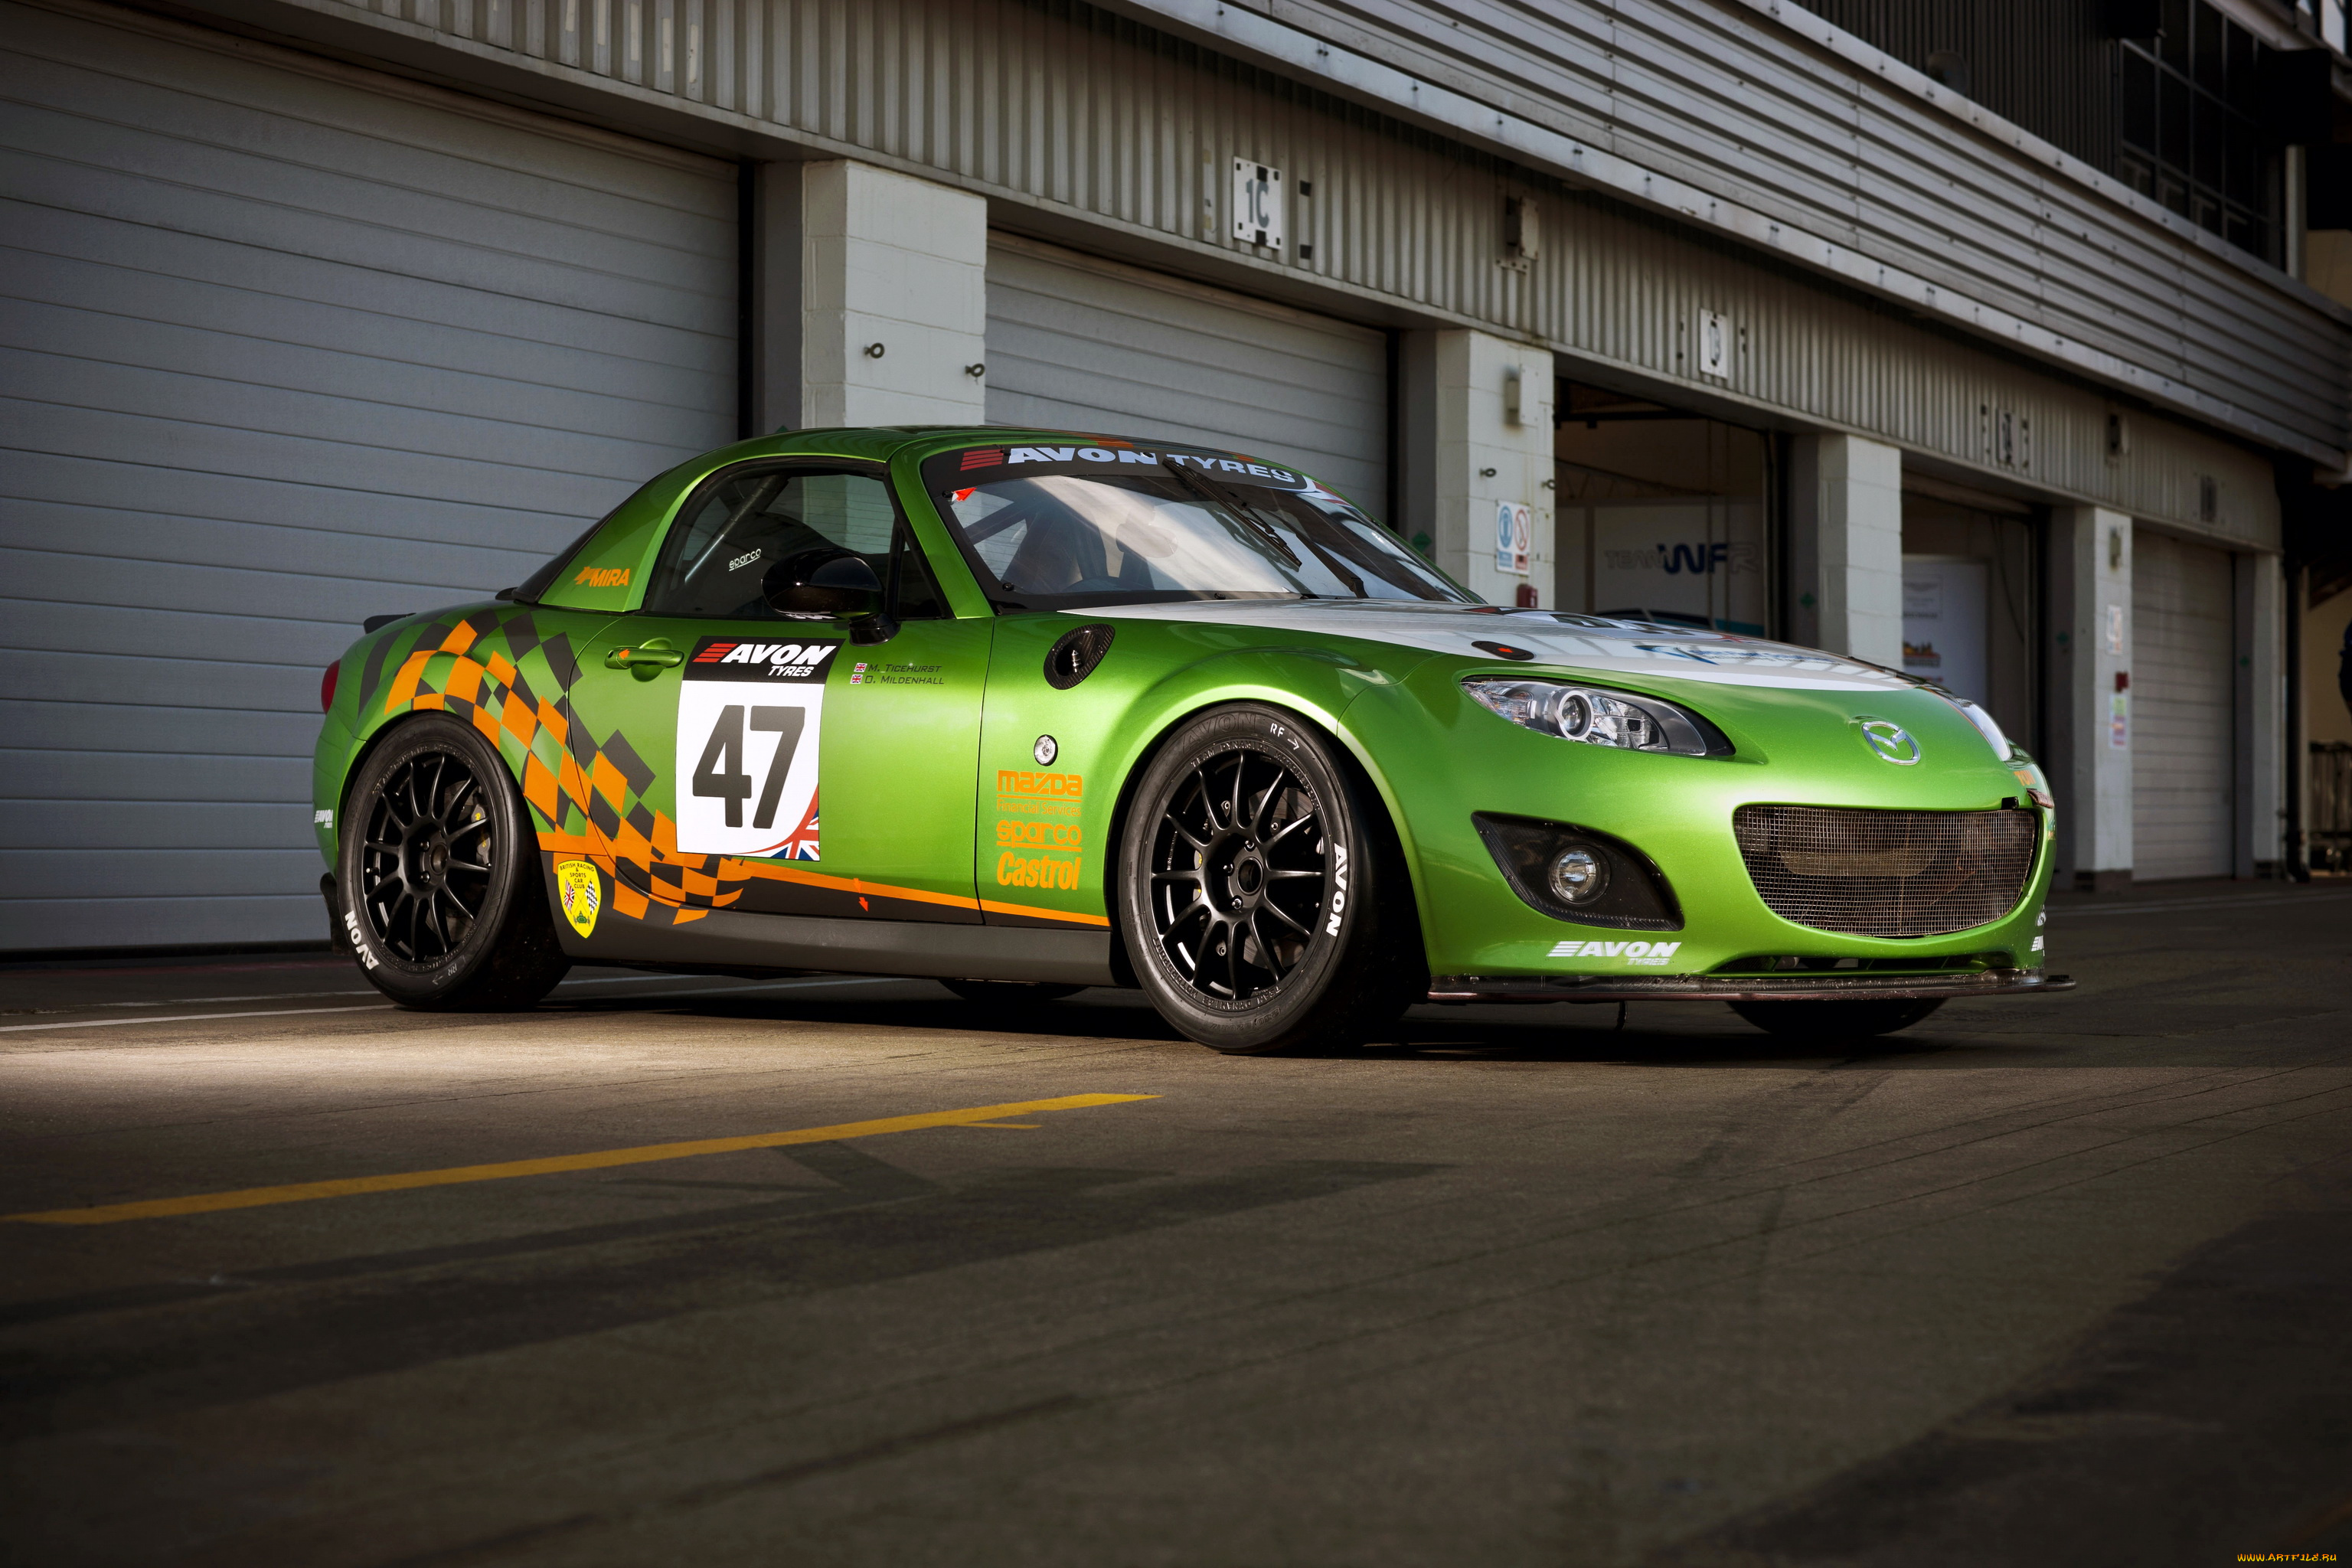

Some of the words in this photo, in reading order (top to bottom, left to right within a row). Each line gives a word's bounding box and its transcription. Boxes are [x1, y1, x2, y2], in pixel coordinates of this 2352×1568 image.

[1008, 446, 1158, 466] AVON
[1166, 453, 1295, 483] TYRES
[590, 568, 630, 587] MIRA
[721, 643, 837, 665] AVON
[767, 665, 815, 677] TYRES
[867, 664, 880, 672] M.
[884, 663, 942, 673] TICEHURST
[880, 675, 944, 685] MILDENHALL
[1269, 722, 1285, 737] RF
[692, 704, 805, 829] 47
[997, 769, 1083, 797] mazda
[997, 799, 1040, 814] Financial
[1041, 802, 1081, 817] Services
[996, 820, 1082, 849] sparco
[560, 863, 576, 871] BRITISH
[577, 863, 594, 872] RACING
[997, 851, 1081, 890] Castrol
[1325, 842, 1348, 937] AVON
[345, 910, 379, 972] AVON
[1576, 941, 1681, 958] AVON
[1627, 957, 1671, 966] TYRES
